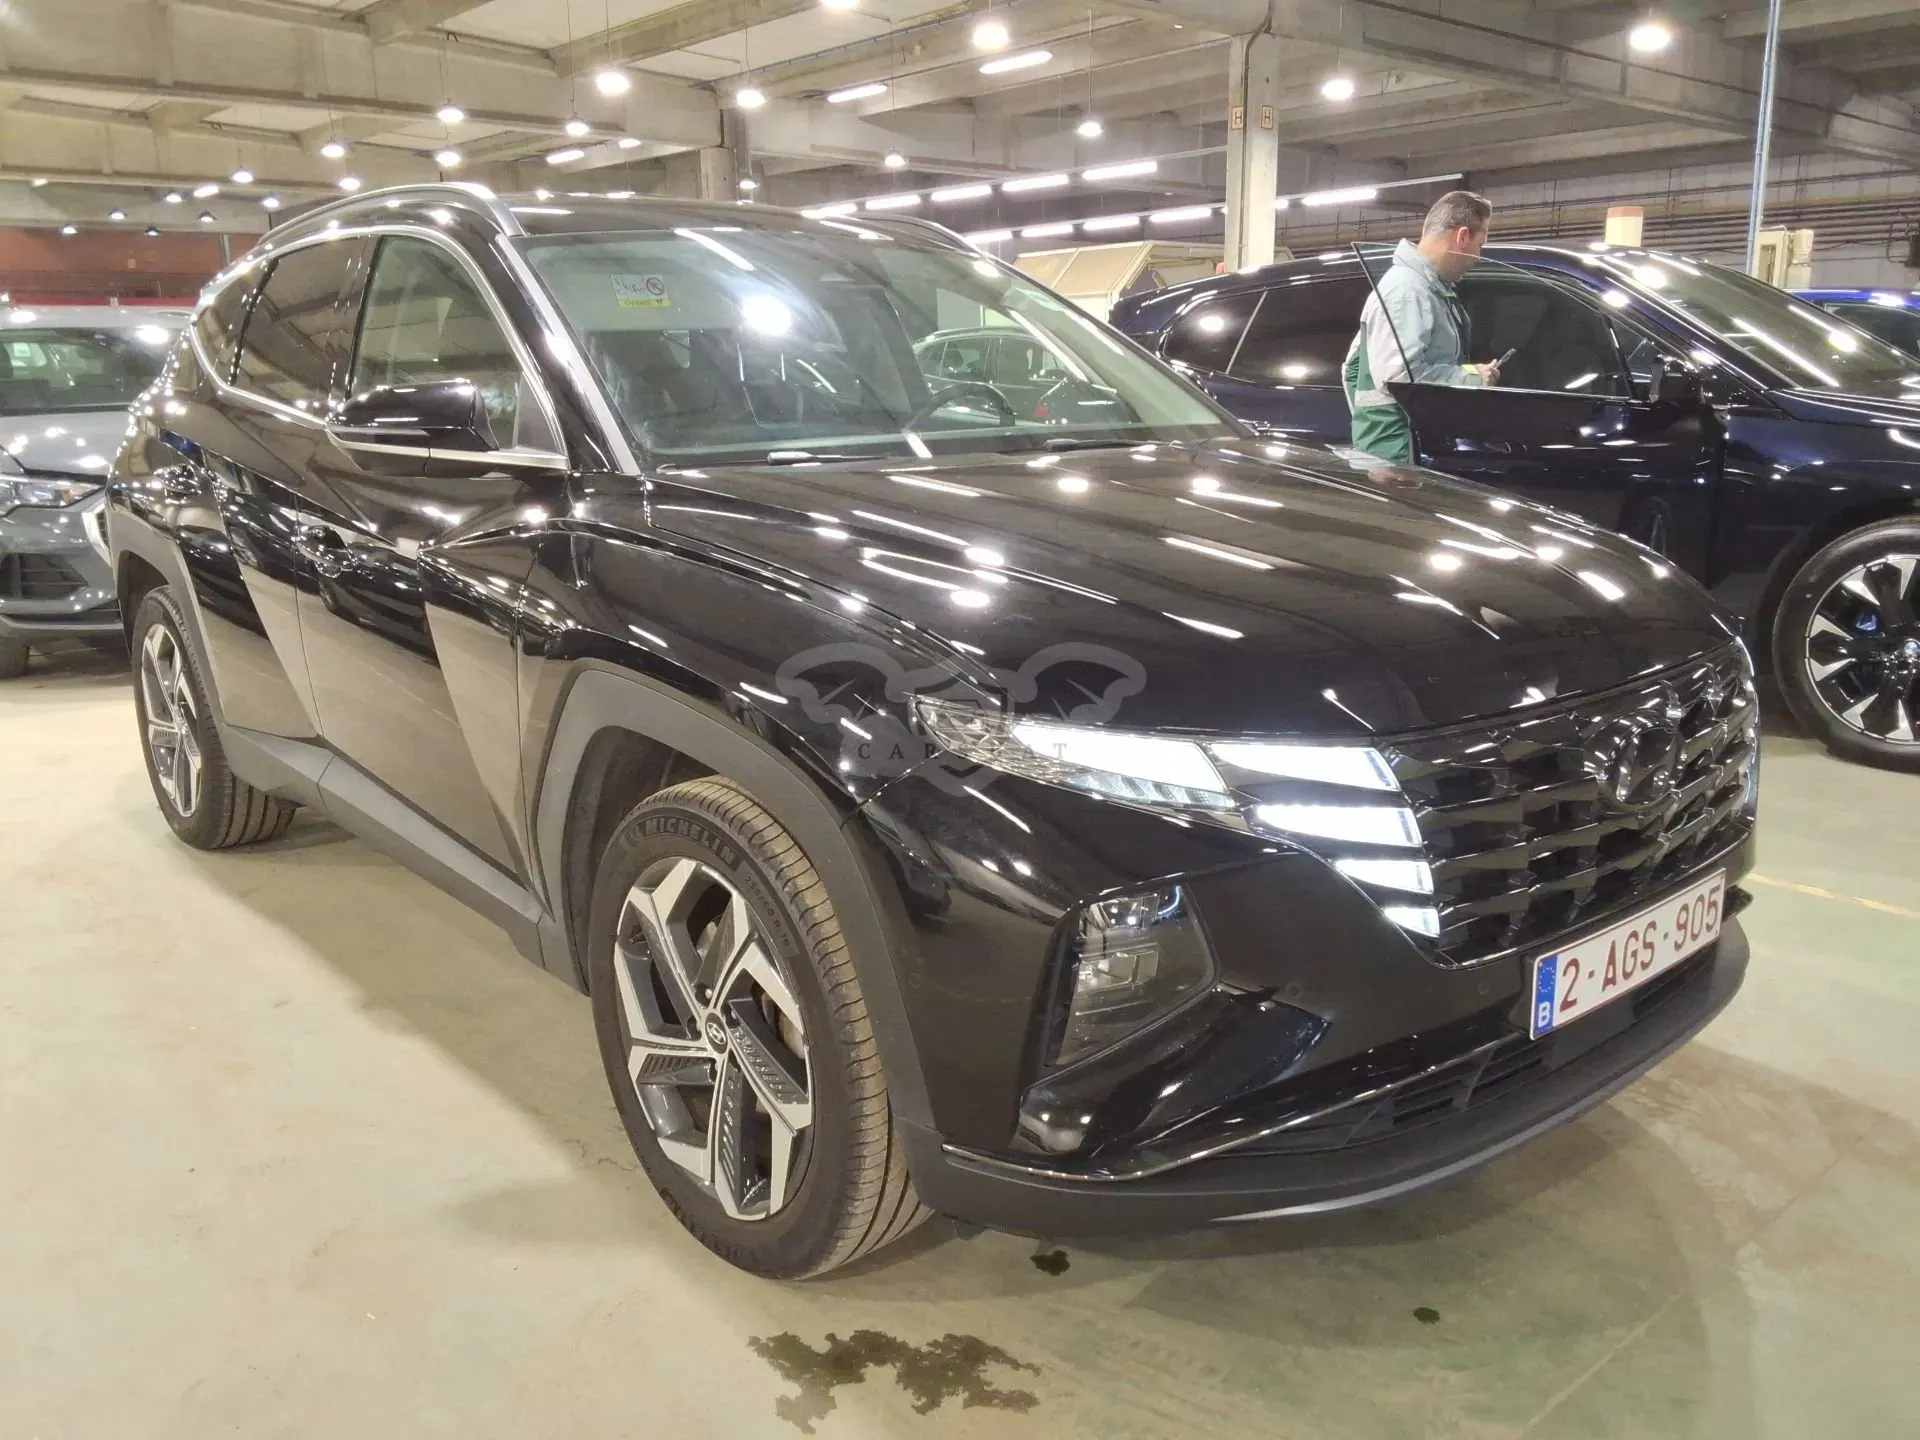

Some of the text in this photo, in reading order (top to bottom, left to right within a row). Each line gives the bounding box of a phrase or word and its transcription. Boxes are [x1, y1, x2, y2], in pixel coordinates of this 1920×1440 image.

[1235, 111, 1243, 125] H
[1264, 109, 1271, 125] H
[644, 816, 737, 865] MICHELIN
[1537, 1001, 1551, 1028] B
